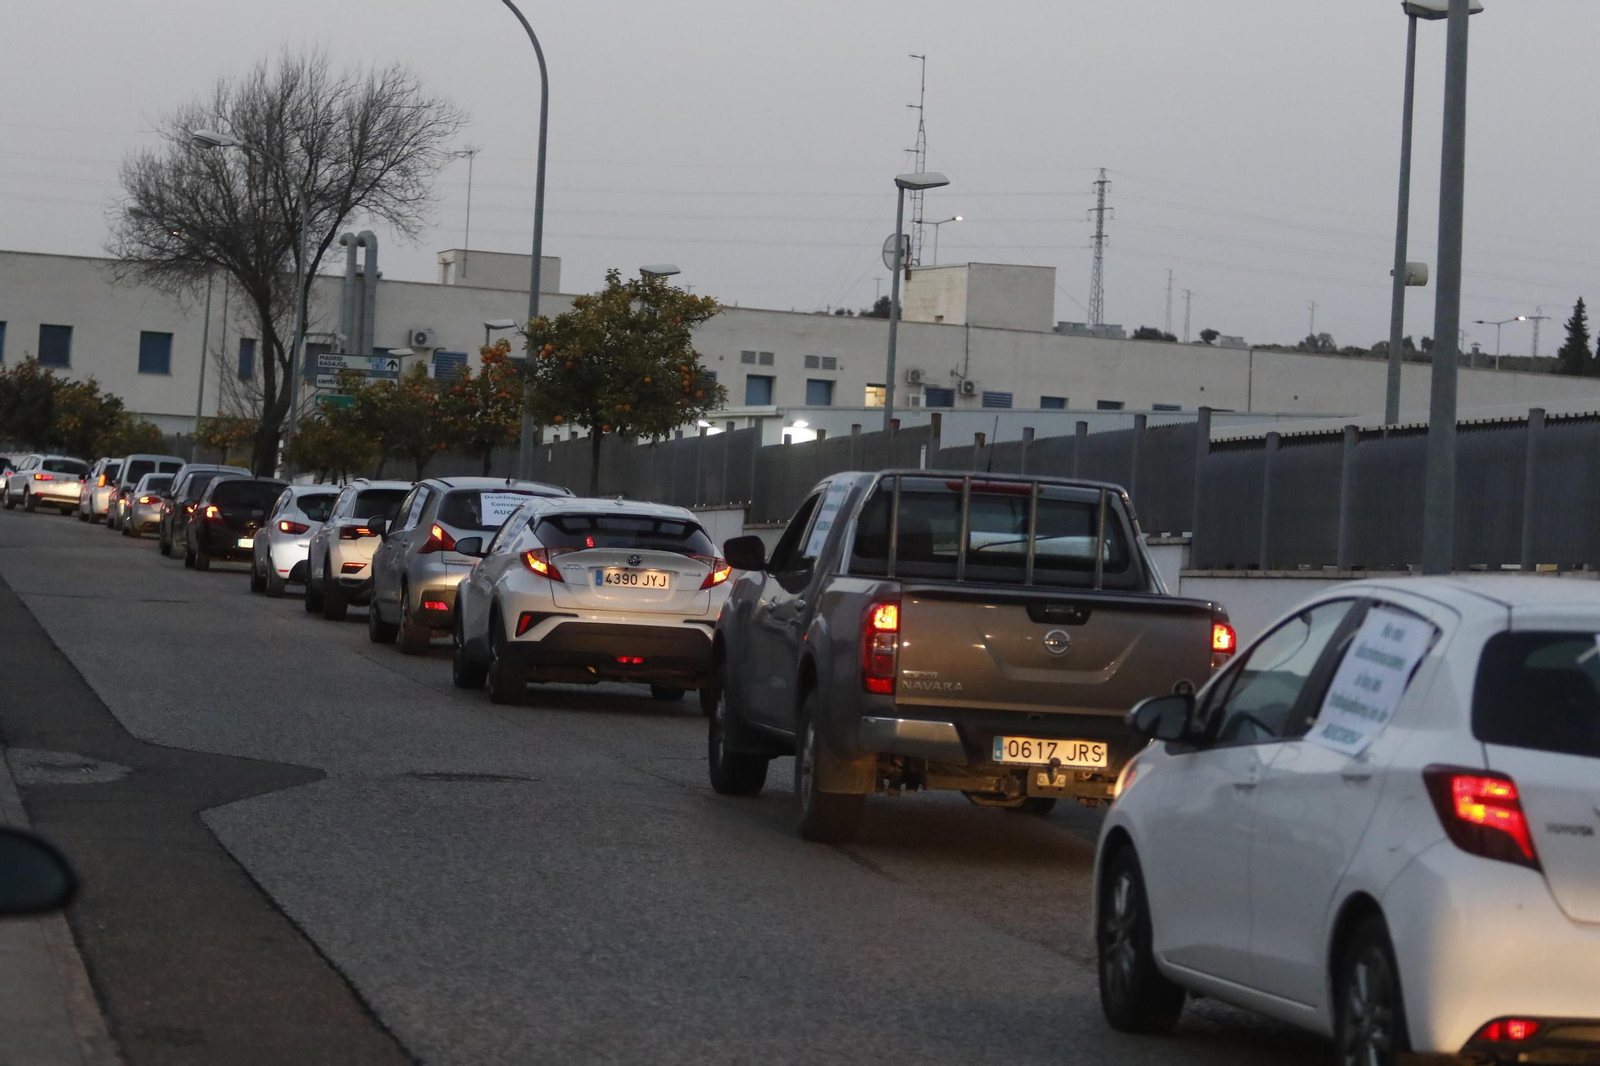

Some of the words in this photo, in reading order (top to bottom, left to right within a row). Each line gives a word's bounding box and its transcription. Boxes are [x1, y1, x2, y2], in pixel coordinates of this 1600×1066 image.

[604, 573, 638, 586] 4390
[642, 575, 667, 587] JYJ
[902, 680, 963, 691] NAVARA
[1008, 740, 1058, 760] 0617
[1066, 743, 1102, 763] JRS
